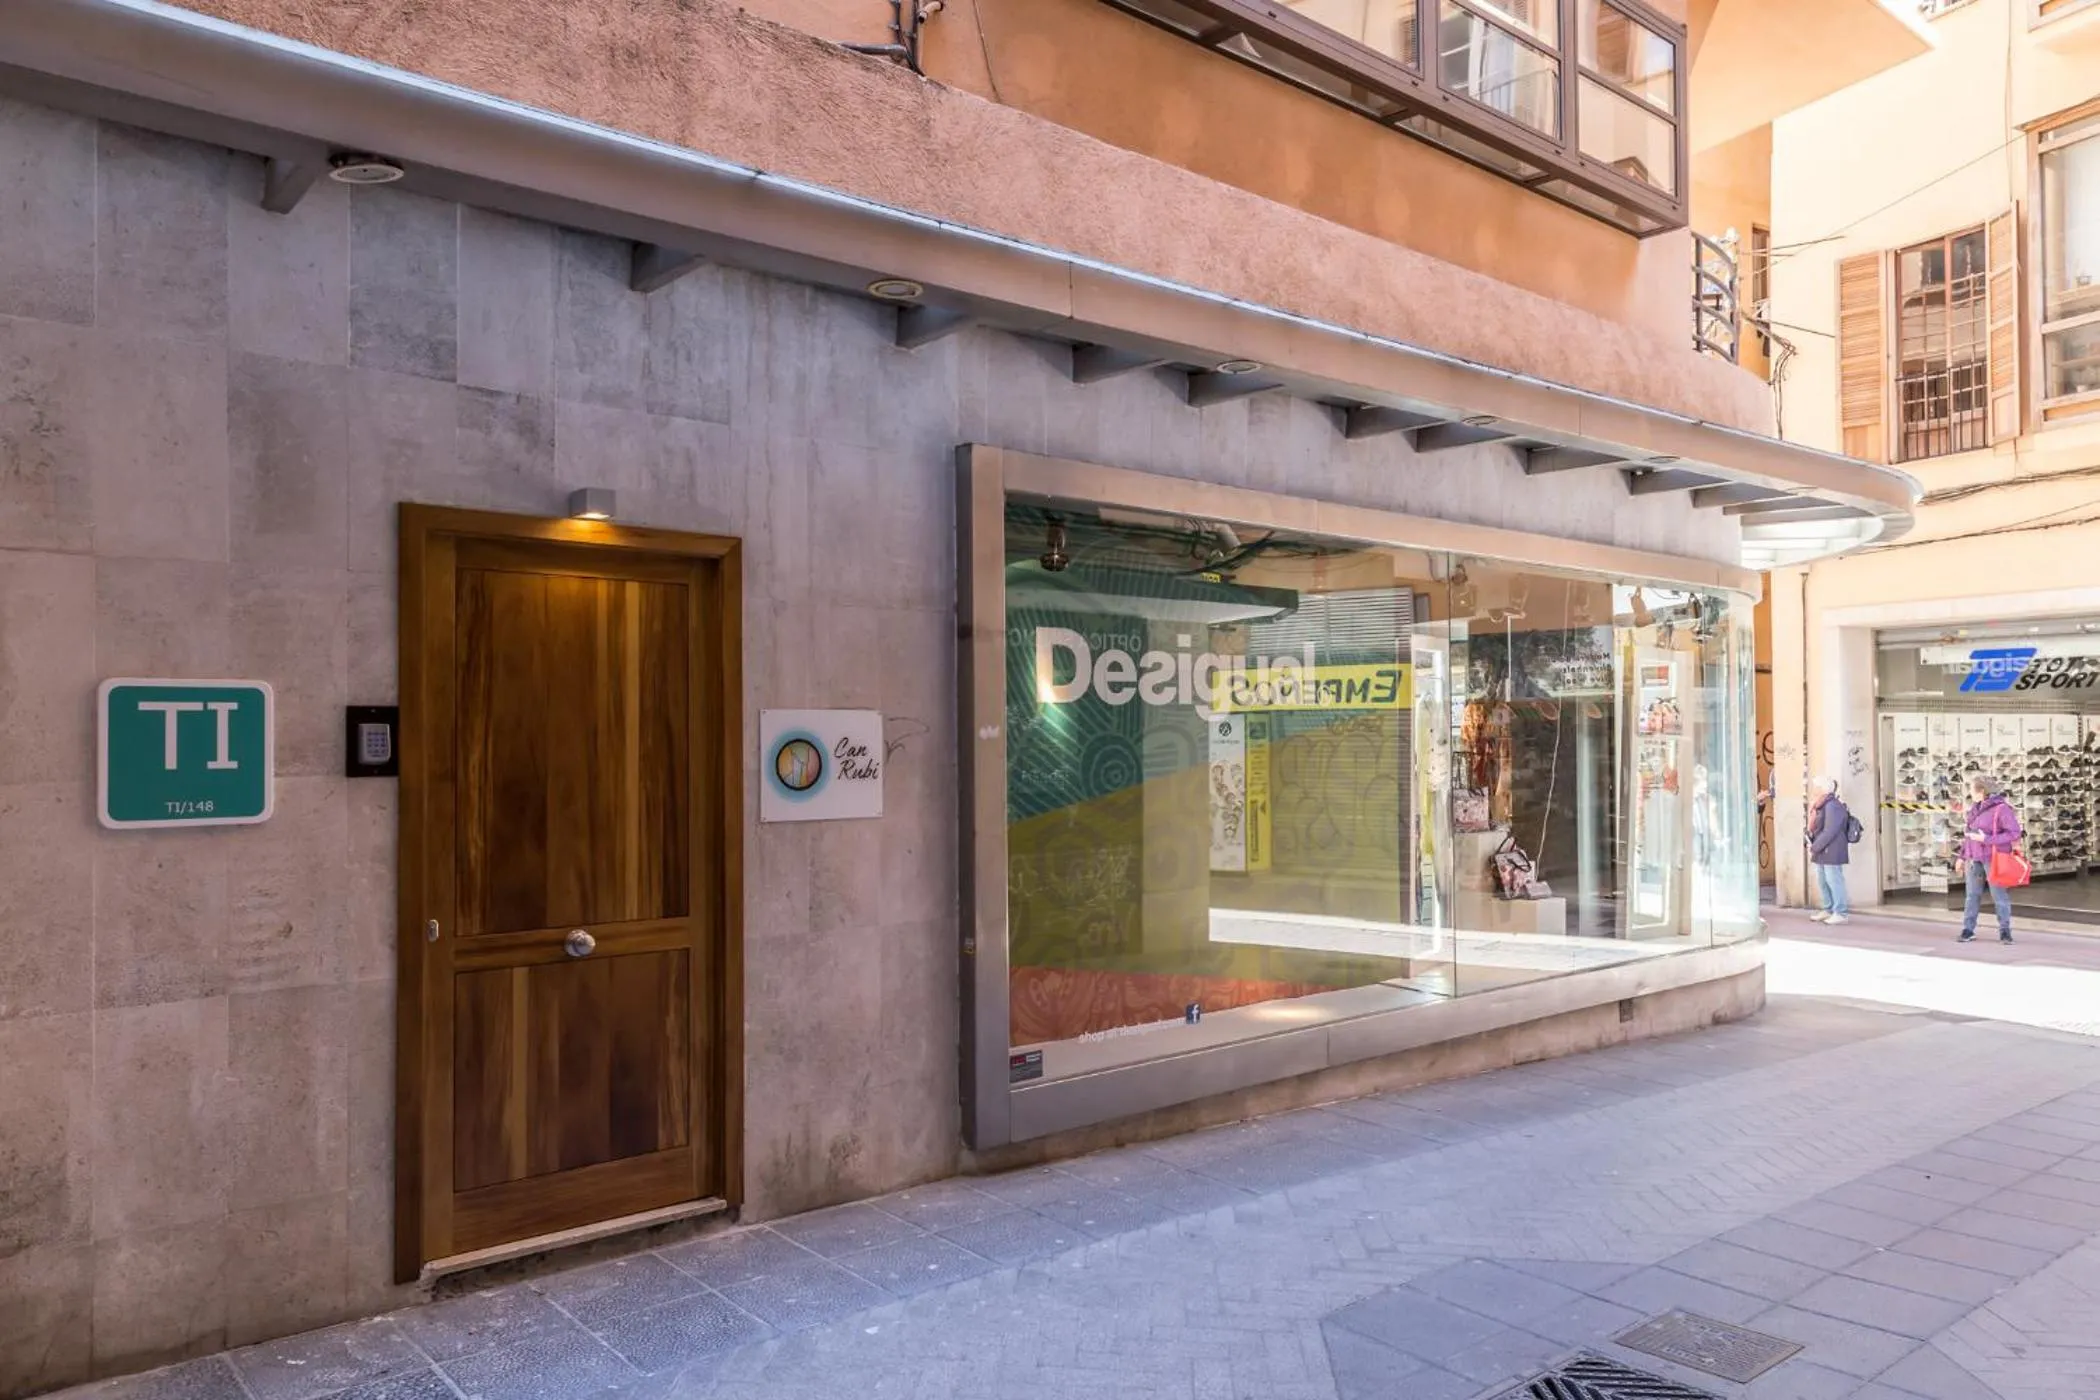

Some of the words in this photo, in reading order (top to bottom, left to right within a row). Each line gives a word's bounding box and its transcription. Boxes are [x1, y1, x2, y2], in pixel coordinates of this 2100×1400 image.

[1035, 626, 1316, 721] Desigual
[2016, 671, 2100, 690] SPORT
[137, 701, 239, 770] TI
[834, 737, 868, 758] Can
[166, 801, 214, 815] TI/148
